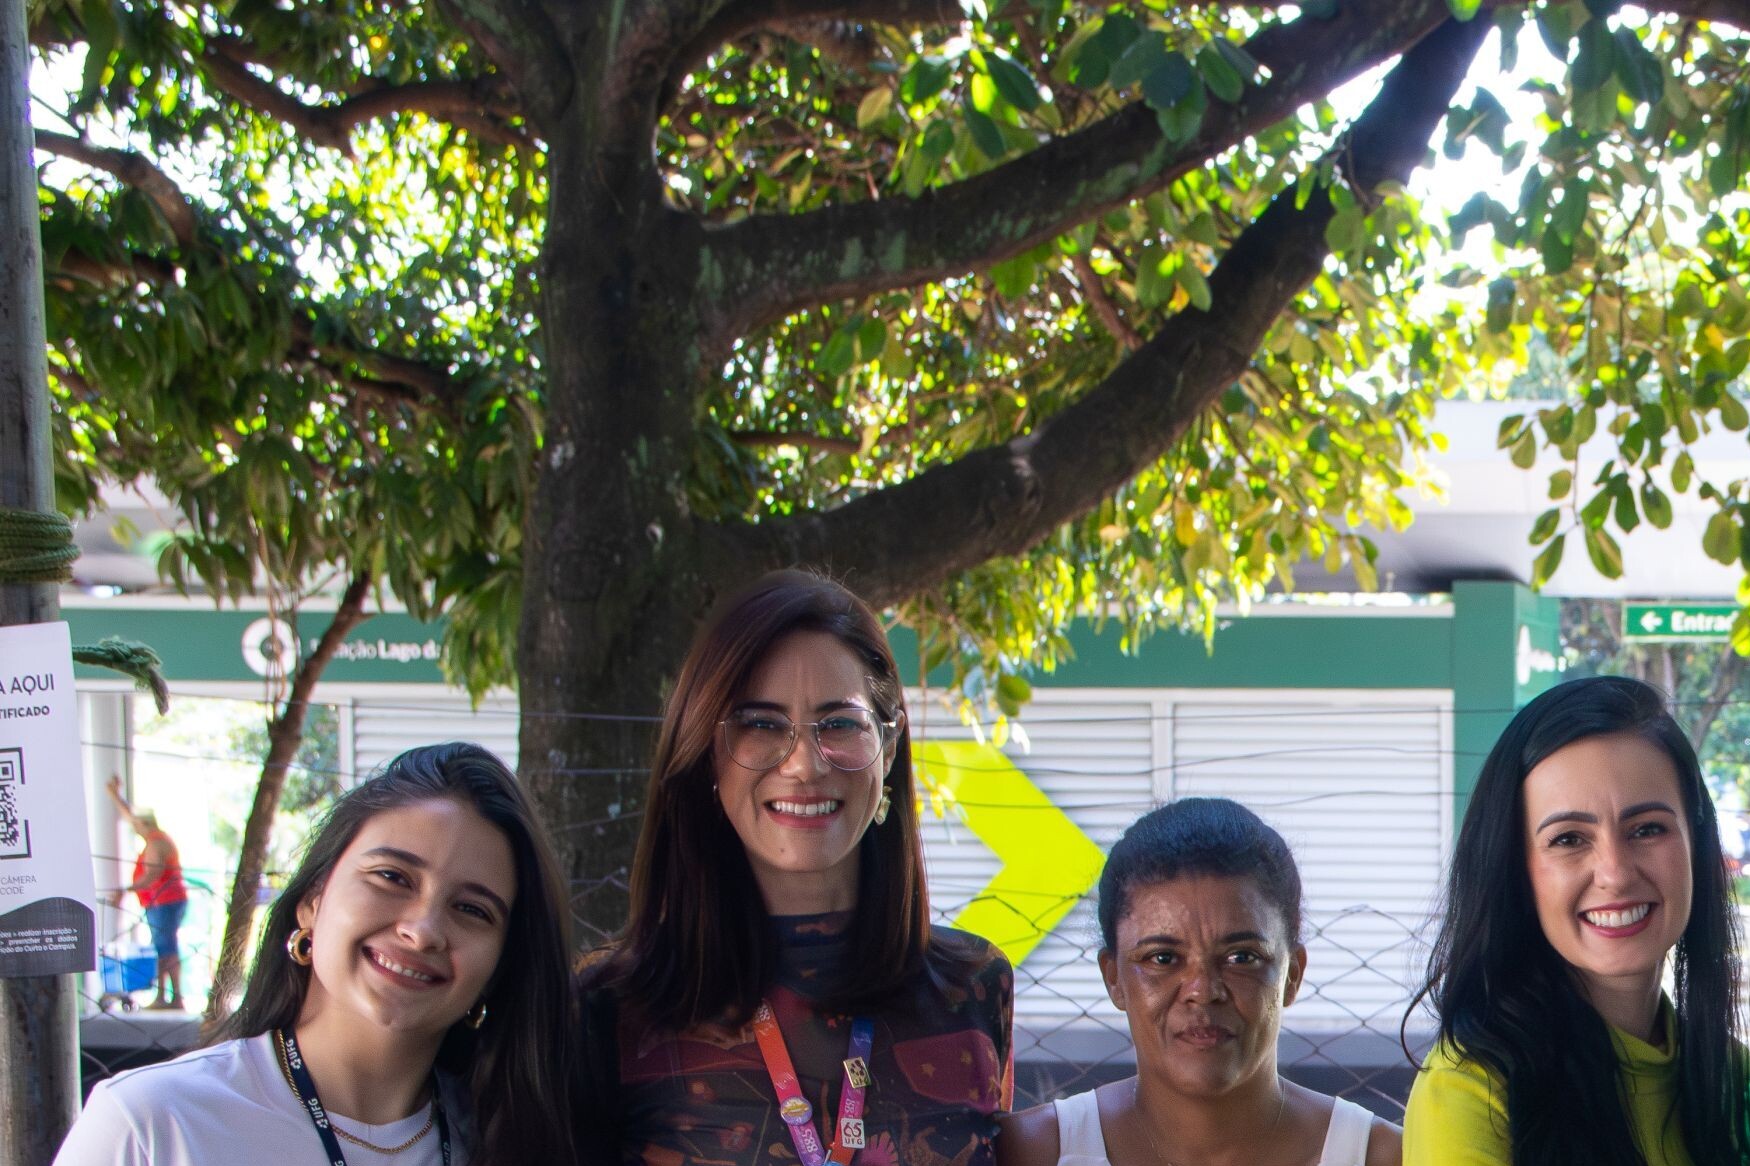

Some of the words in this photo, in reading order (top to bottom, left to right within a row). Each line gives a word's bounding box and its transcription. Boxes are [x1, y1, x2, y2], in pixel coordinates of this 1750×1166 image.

[377, 638, 421, 662] Lago
[11, 673, 54, 695] AQUI
[286, 1038, 299, 1061] UFG
[308, 1098, 323, 1119] UFG
[843, 1122, 862, 1137] 65
